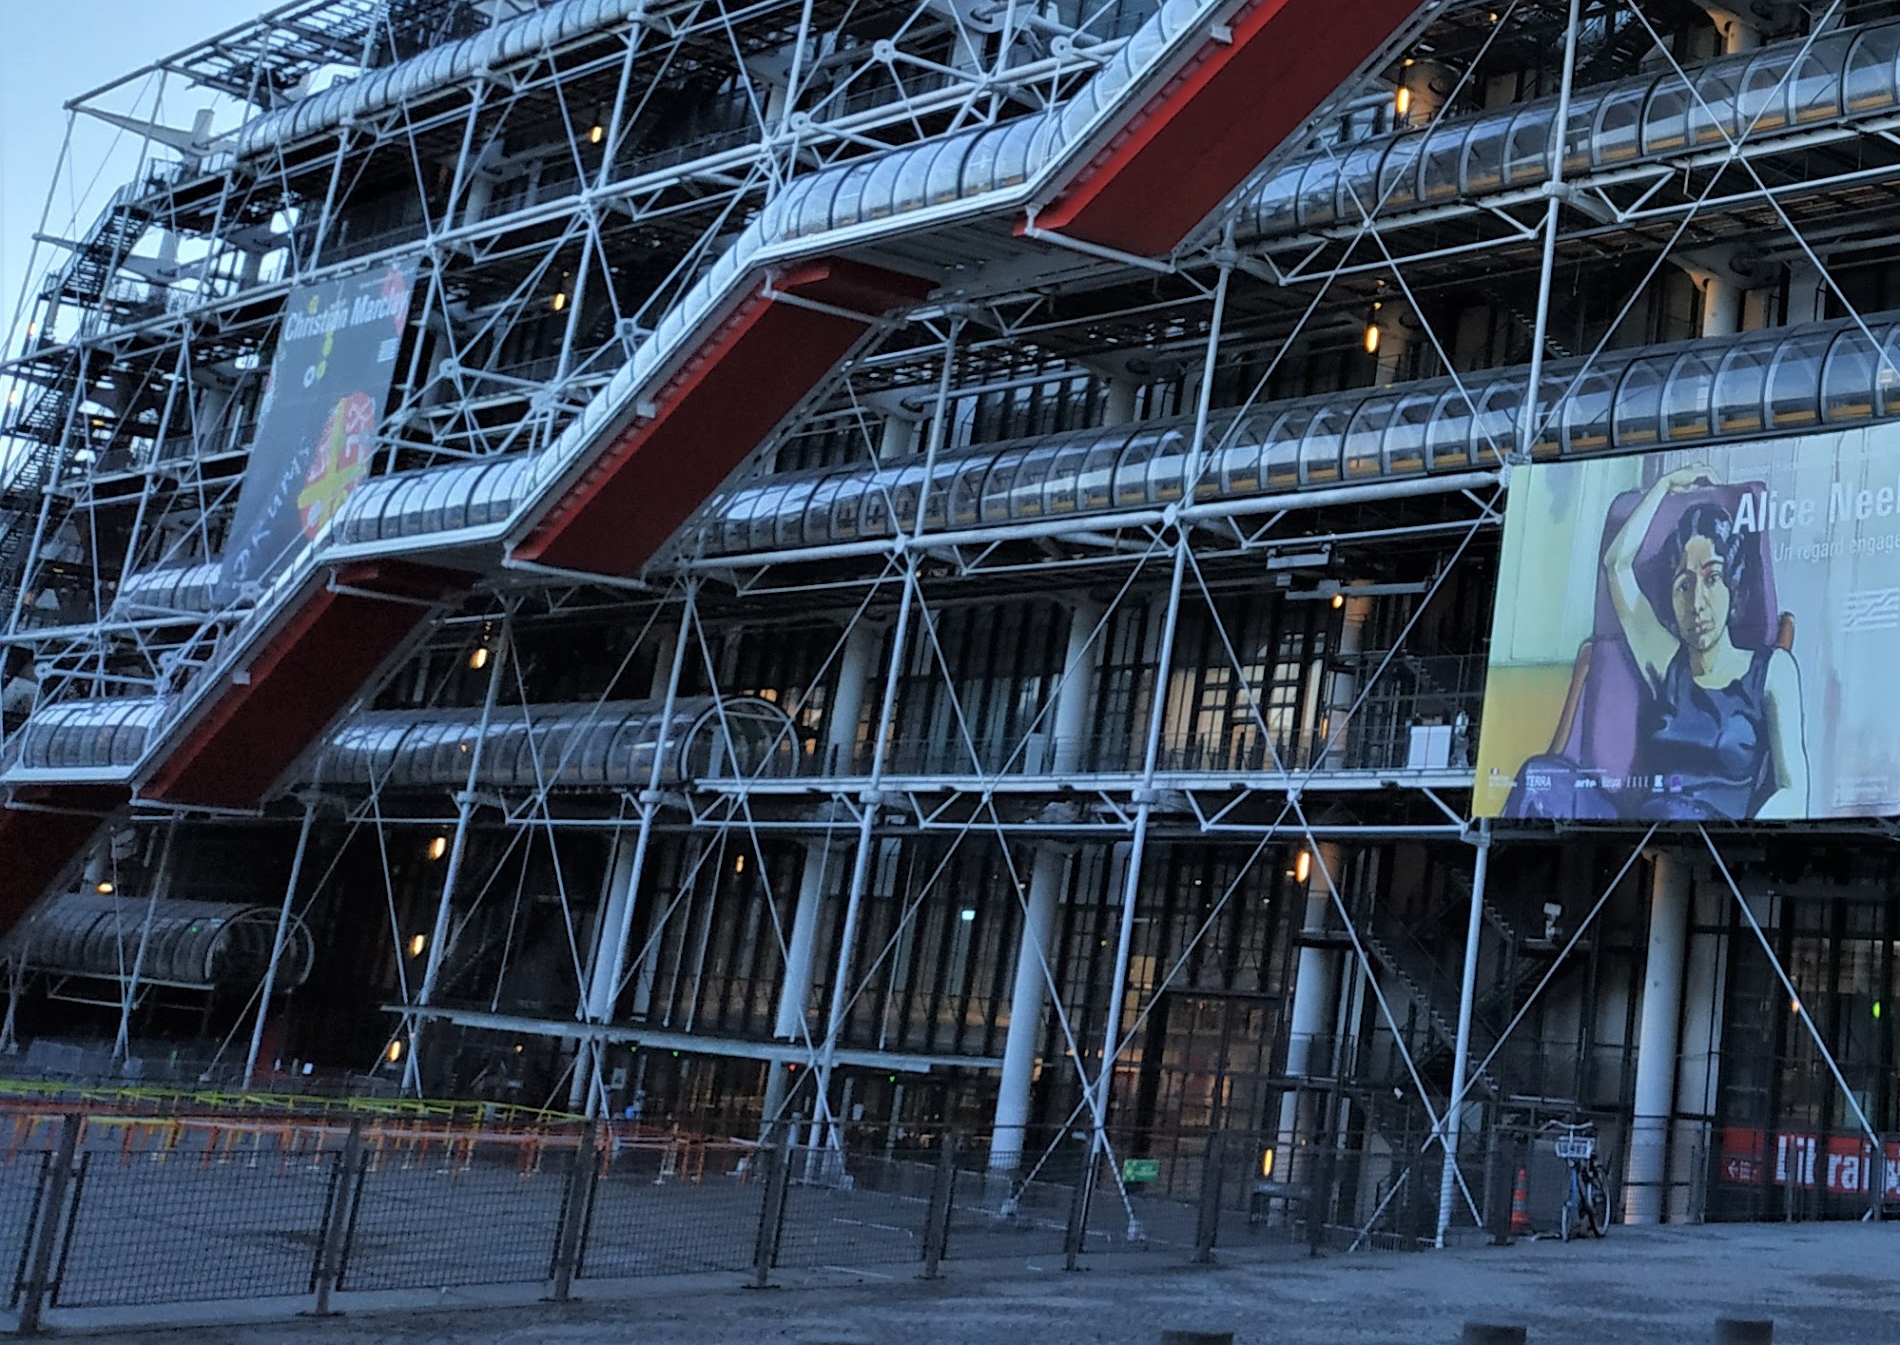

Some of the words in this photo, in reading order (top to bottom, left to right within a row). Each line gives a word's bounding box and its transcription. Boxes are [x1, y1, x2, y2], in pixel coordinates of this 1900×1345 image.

[283, 308, 349, 342] Christian
[350, 287, 410, 326] Marclay
[1732, 490, 1816, 535] Alice
[1773, 542, 1792, 563] Un
[1798, 538, 1844, 564] regard
